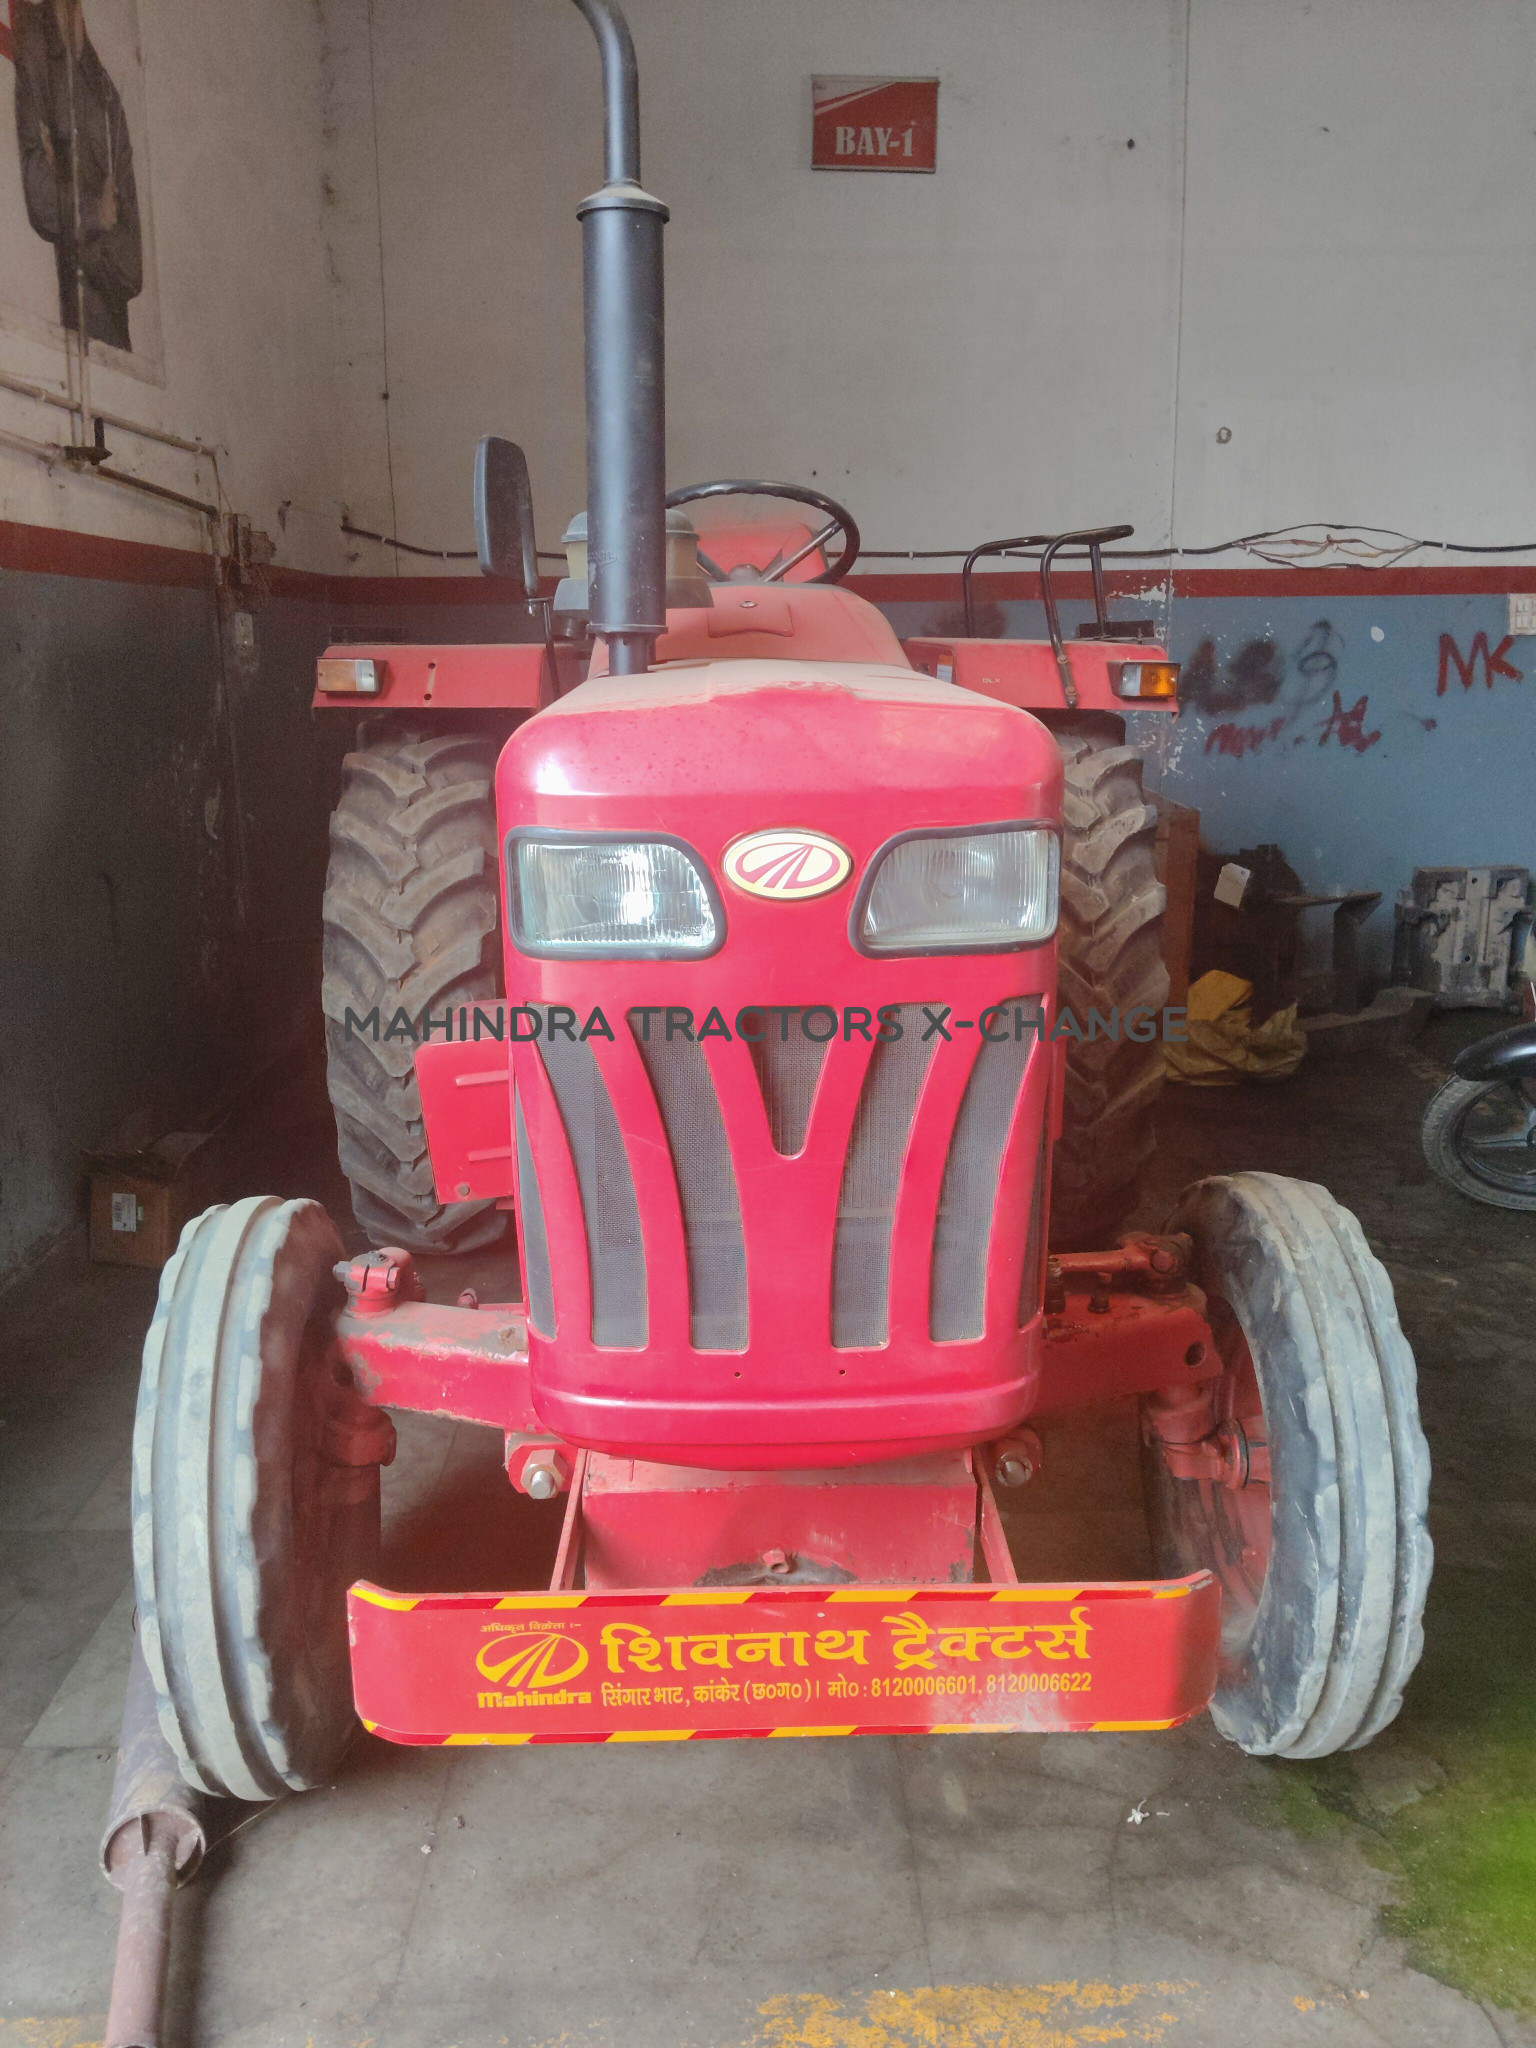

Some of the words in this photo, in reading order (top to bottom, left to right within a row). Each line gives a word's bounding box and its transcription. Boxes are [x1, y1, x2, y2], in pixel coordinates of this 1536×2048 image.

[835, 126, 913, 157] BAY-1
[600, 1622, 871, 1674] शिवनाथ
[881, 1605, 1094, 1671] ट्रैक्टर्स
[986, 1672, 1092, 1694] 8120006622
